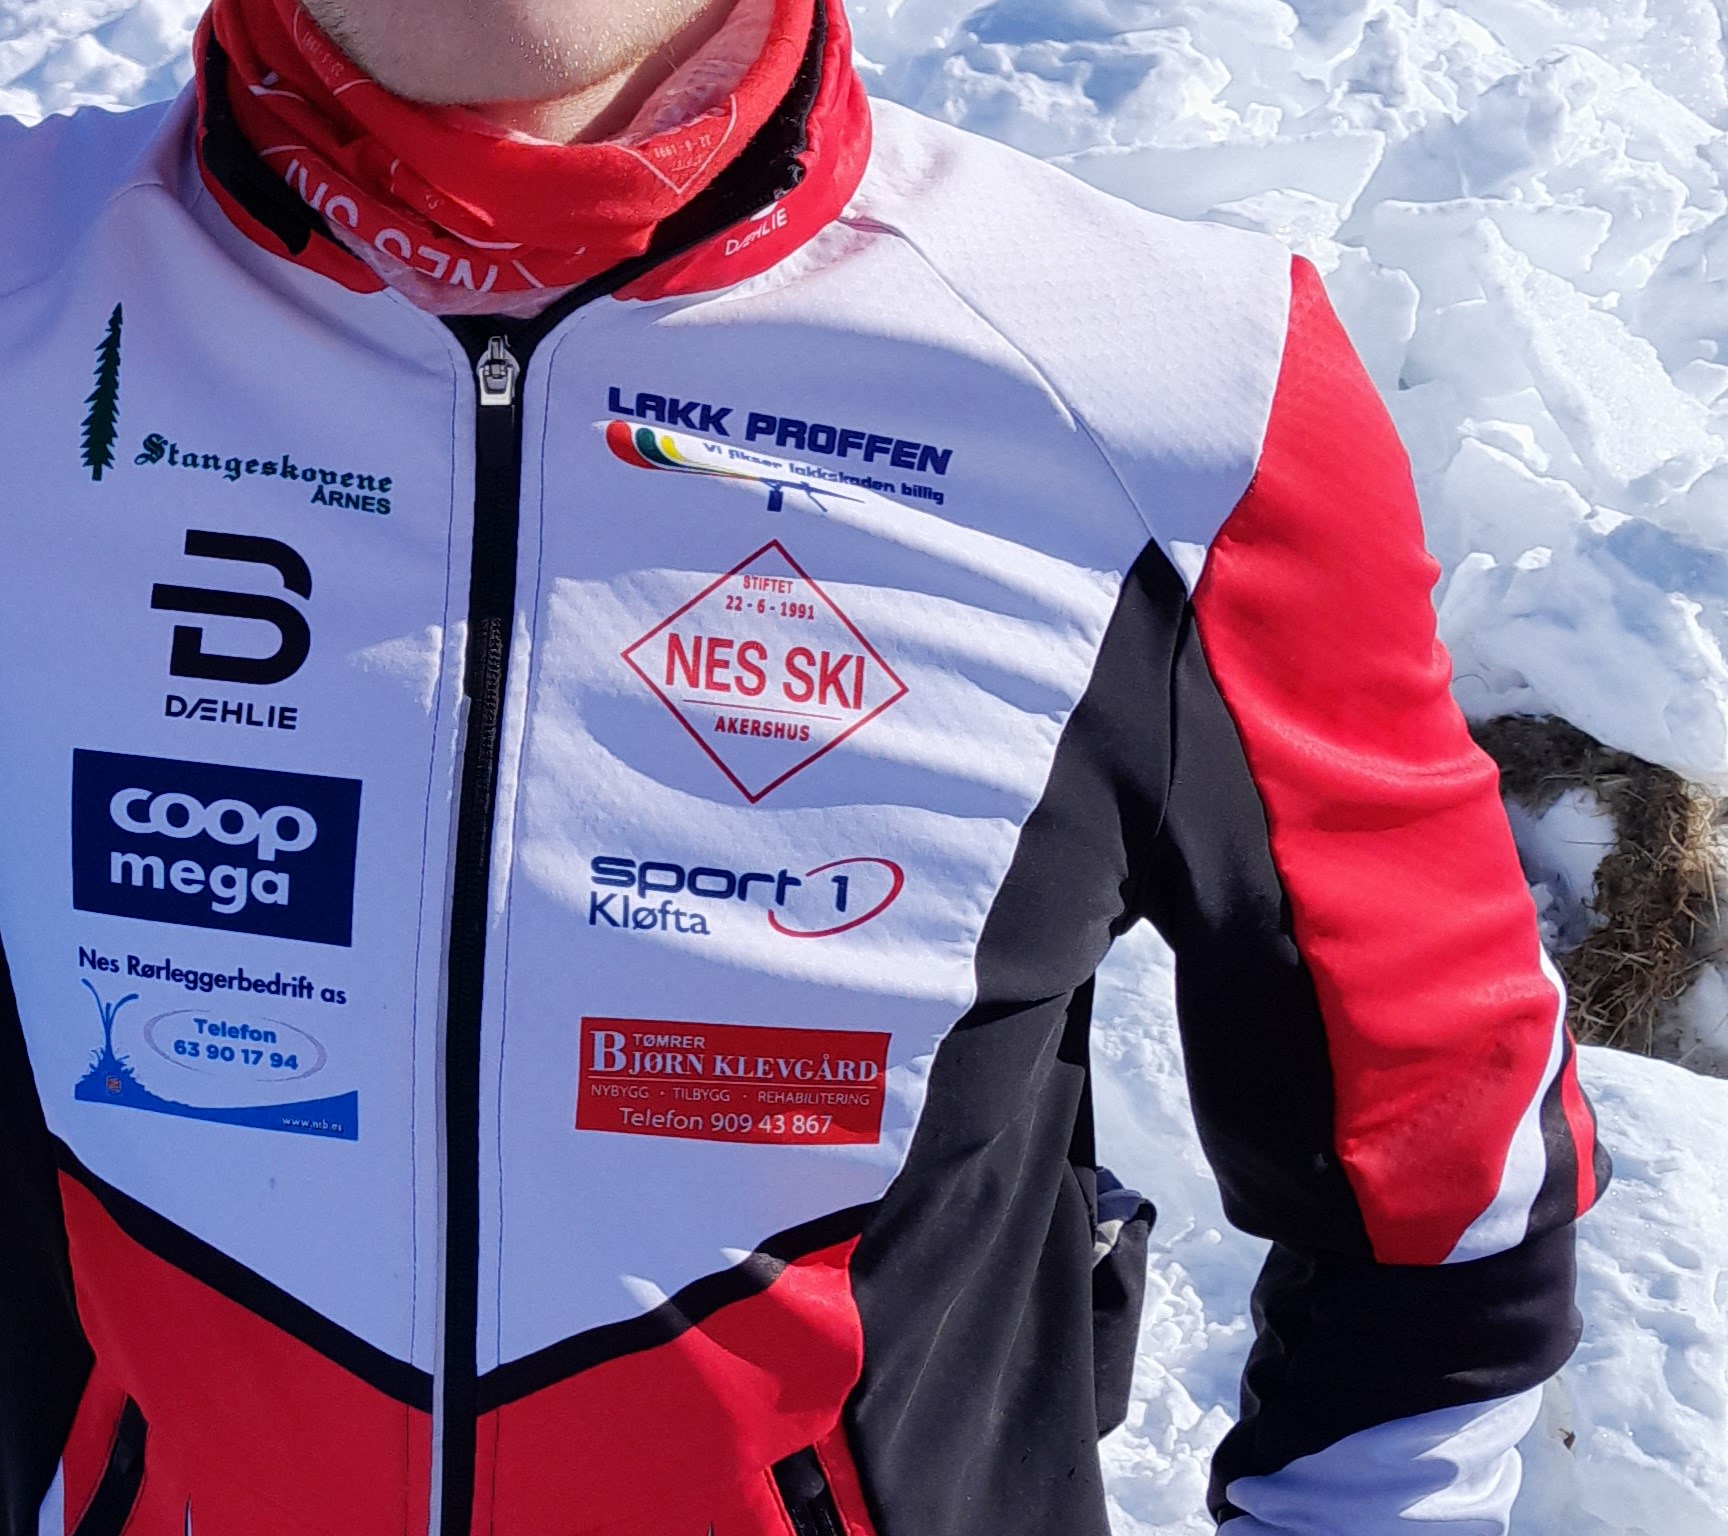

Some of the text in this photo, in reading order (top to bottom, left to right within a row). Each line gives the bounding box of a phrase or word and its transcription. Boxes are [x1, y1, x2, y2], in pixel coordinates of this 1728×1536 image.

[725, 208, 788, 257] DÆHLIE
[608, 387, 953, 476] LAKK PROFFEN
[134, 433, 393, 493] Stangeskovene
[311, 484, 391, 515] ÅRNES
[901, 482, 944, 505] billig
[743, 575, 793, 594] STIFTET
[666, 633, 865, 710] NES SKI
[165, 694, 298, 730] DÆHLIE
[714, 716, 810, 742] AKERSHUS
[109, 788, 318, 862] coop
[110, 851, 290, 914] mega
[591, 855, 848, 912] sport 1
[589, 891, 711, 935] Kløfta
[79, 946, 348, 1005] Nes Rørleggerbedrift as
[193, 1017, 277, 1044] Telefon
[633, 1032, 706, 1049] TØMRER
[174, 1040, 299, 1071] 63 90 17 94
[589, 1030, 878, 1083] BJØRN KLEVGÅRD
[591, 1085, 870, 1106] NYBYGG TILBYGG REHABILITERING
[619, 1107, 832, 1134] Telefon 909 43 867
